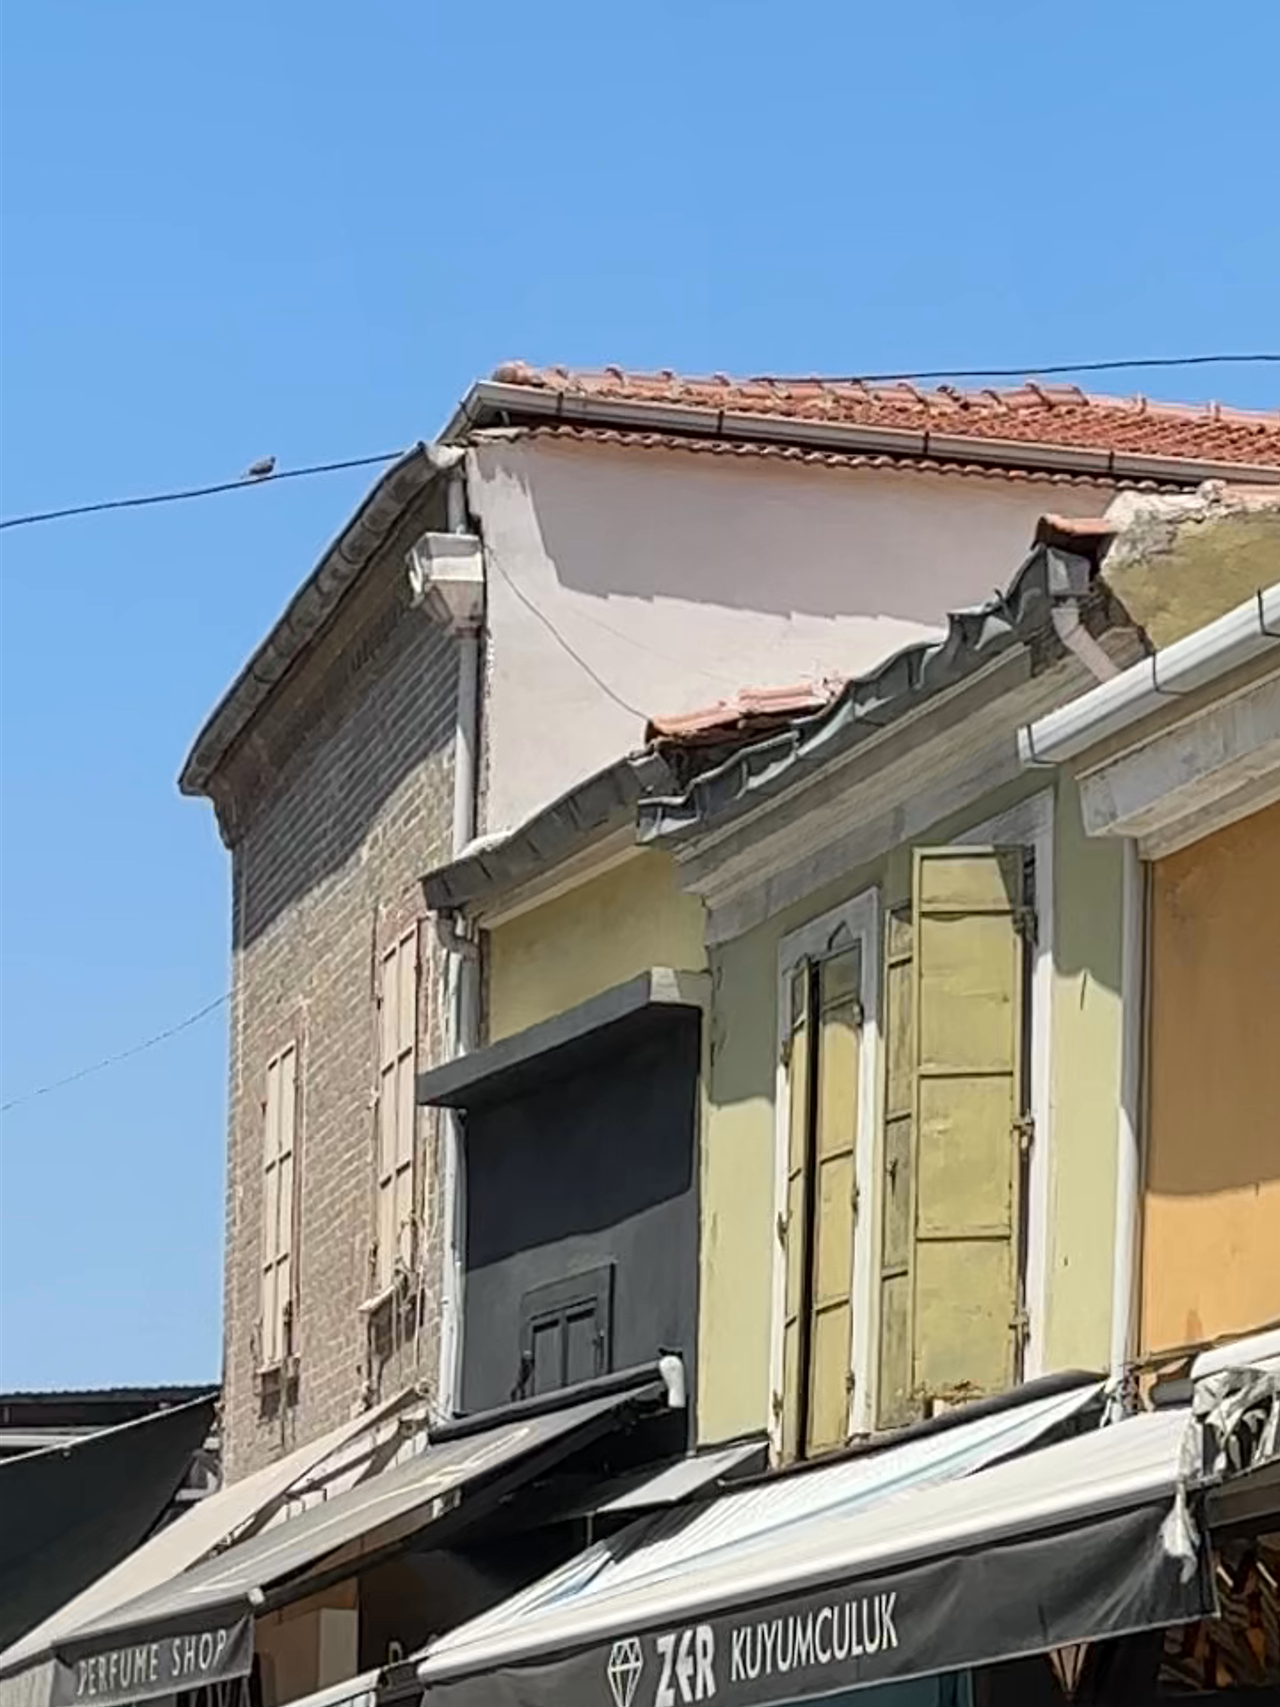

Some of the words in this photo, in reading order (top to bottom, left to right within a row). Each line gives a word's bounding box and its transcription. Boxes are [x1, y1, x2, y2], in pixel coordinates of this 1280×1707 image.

[76, 1642, 158, 1696] PERFUME
[171, 1629, 228, 1677] SHOP
[731, 1591, 899, 1682] KUYUMCULUK
